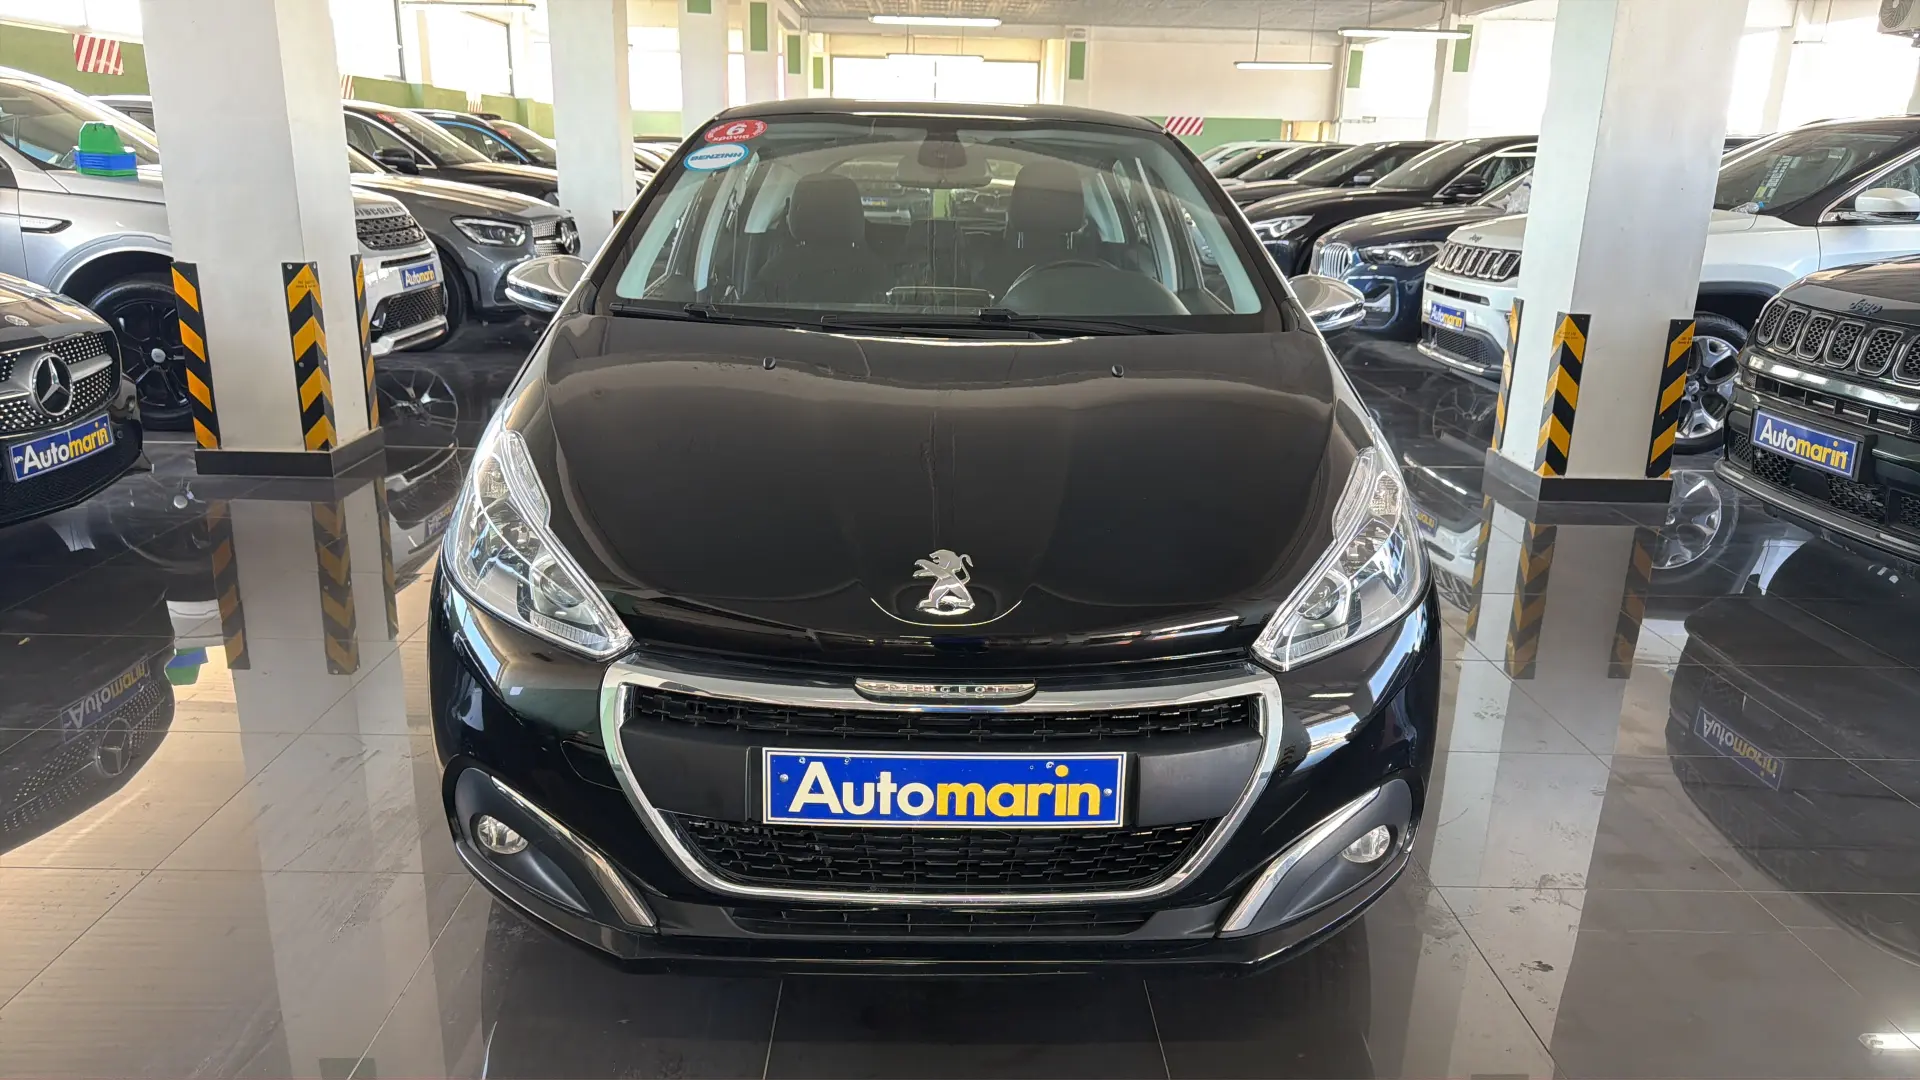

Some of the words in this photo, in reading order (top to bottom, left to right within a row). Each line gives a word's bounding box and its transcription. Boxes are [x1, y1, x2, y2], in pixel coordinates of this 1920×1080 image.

[726, 123, 748, 136] 6
[23, 421, 109, 474] Automarin
[1760, 418, 1848, 470] Automarin
[788, 761, 1100, 817] Automarin
